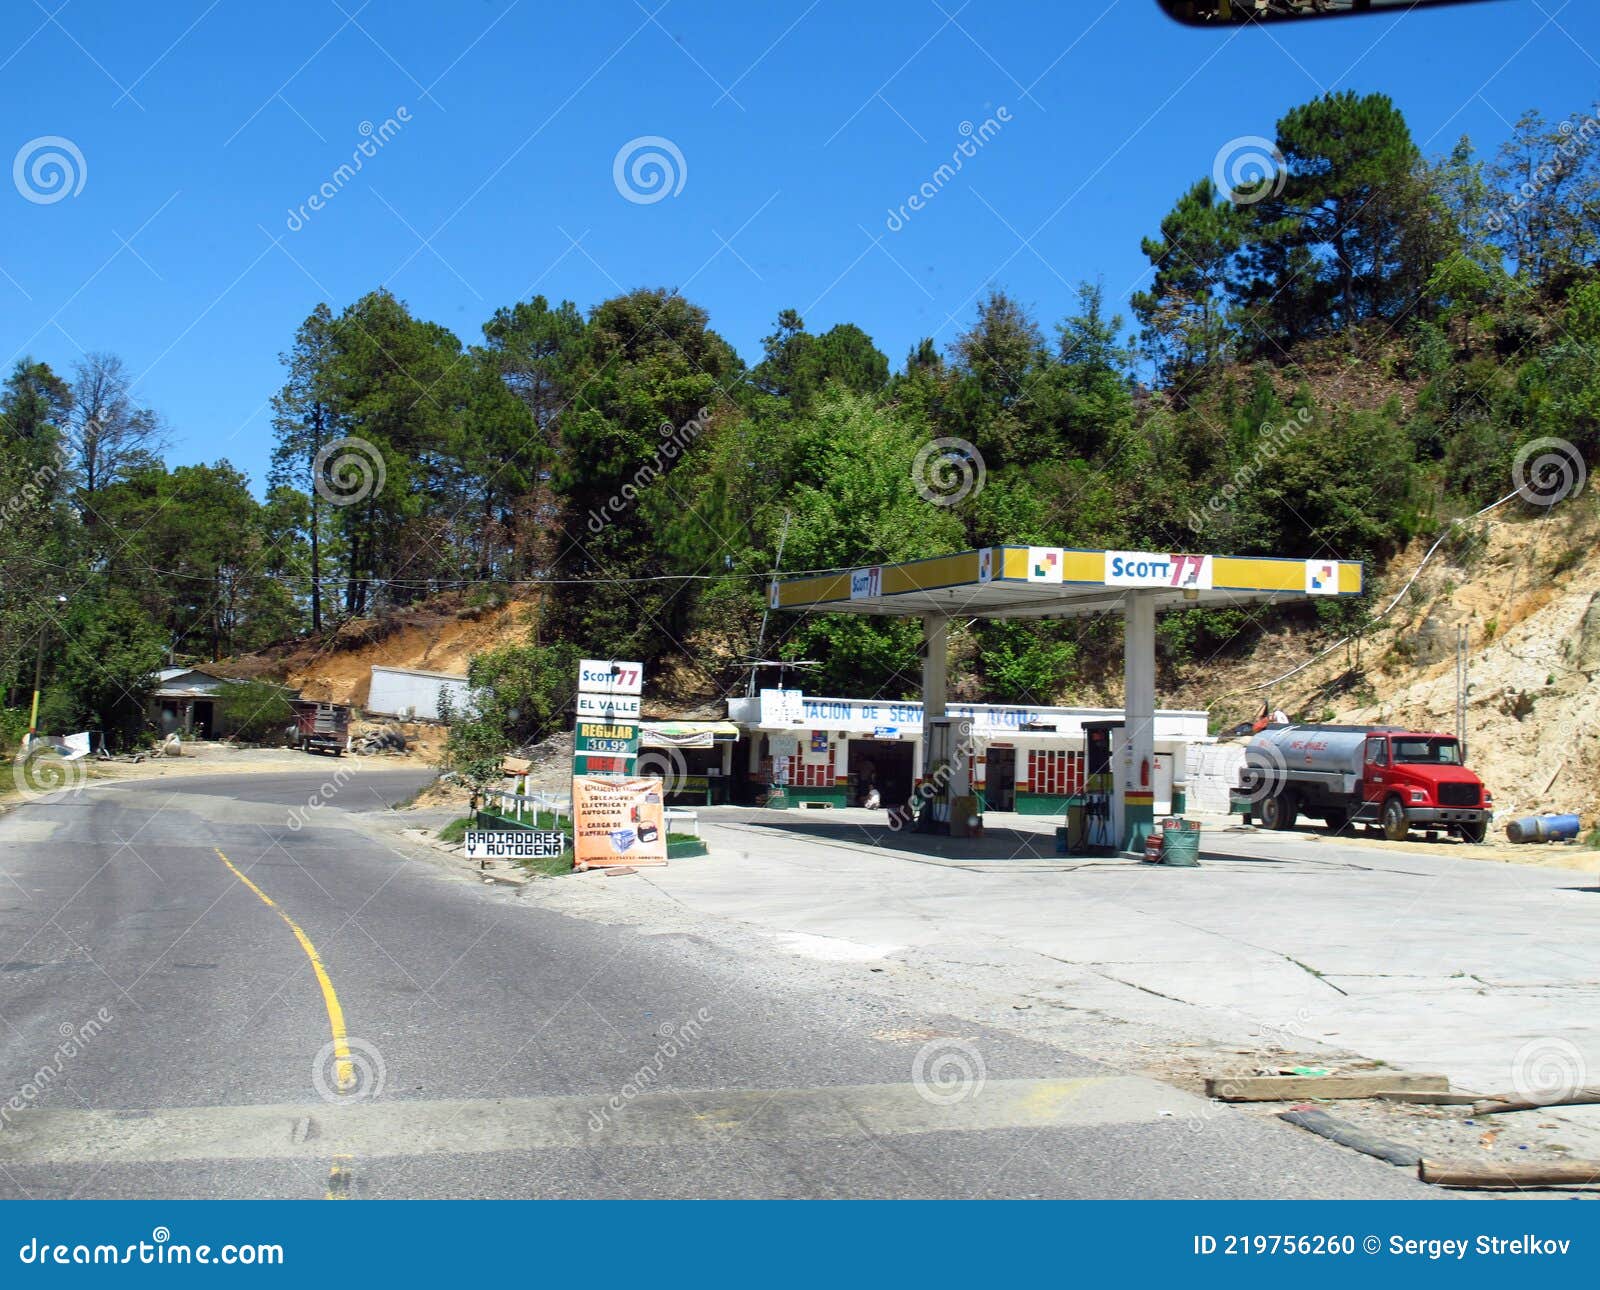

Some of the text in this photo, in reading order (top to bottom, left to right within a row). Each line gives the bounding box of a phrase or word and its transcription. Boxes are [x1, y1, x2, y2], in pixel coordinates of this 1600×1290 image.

[580, 700, 638, 712] EL VALLE
[804, 702, 850, 719] TACION
[862, 706, 878, 719] DE
[581, 724, 633, 739] REGULAR
[590, 740, 627, 751] 30.99
[468, 832, 561, 844] RADIADORES
[468, 845, 561, 855] Y AUTOGENA
